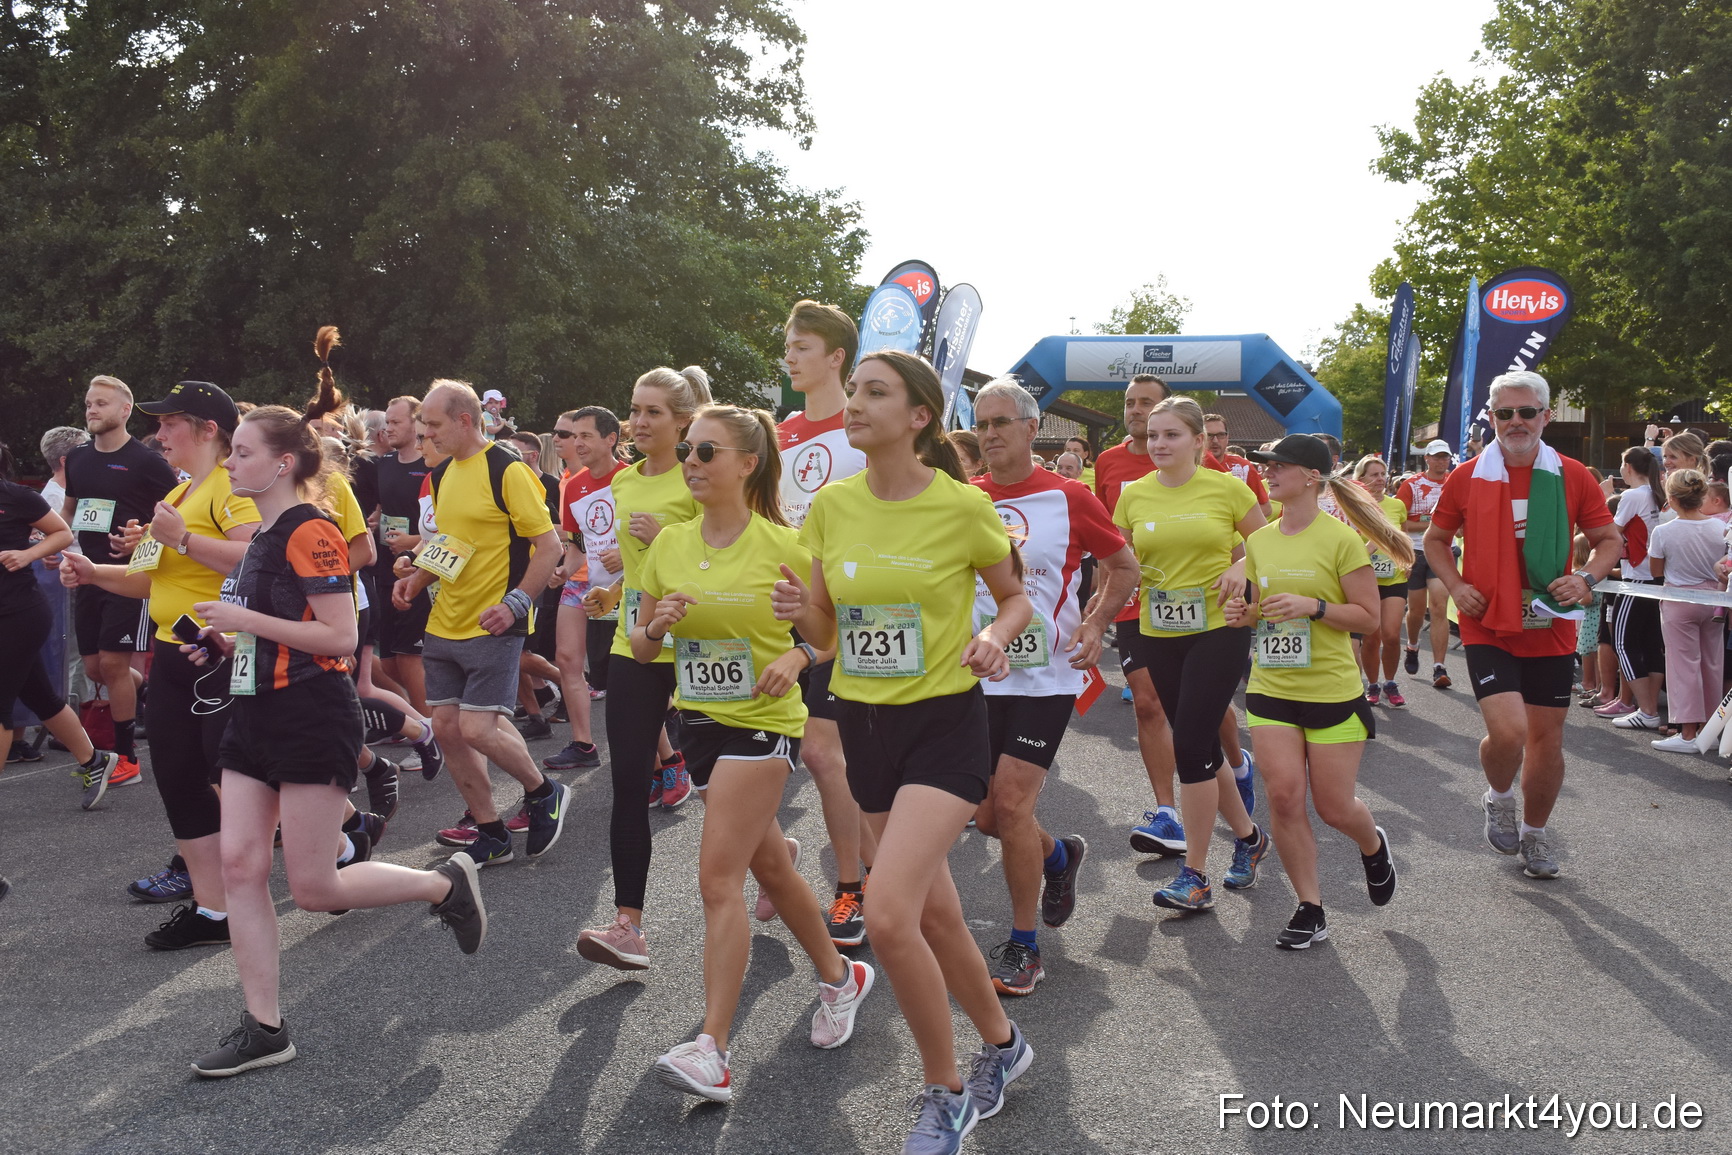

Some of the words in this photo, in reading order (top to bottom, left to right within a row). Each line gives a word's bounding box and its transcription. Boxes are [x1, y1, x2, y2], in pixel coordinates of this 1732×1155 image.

[1492, 289, 1559, 314] Hervis
[946, 298, 969, 360] Fischer
[956, 307, 973, 356] AUTOMOBILE
[1132, 362, 1198, 375] firmenlauf
[82, 510, 97, 522] 50
[132, 540, 159, 562] 2005
[312, 549, 338, 560] brand
[423, 545, 459, 569] 2011
[1155, 604, 1196, 620] 1211
[846, 629, 906, 657] 1231
[1263, 636, 1303, 654] 1238
[879, 656, 897, 664] Julia
[684, 661, 743, 684] 1306
[1016, 735, 1041, 748] JAKO
